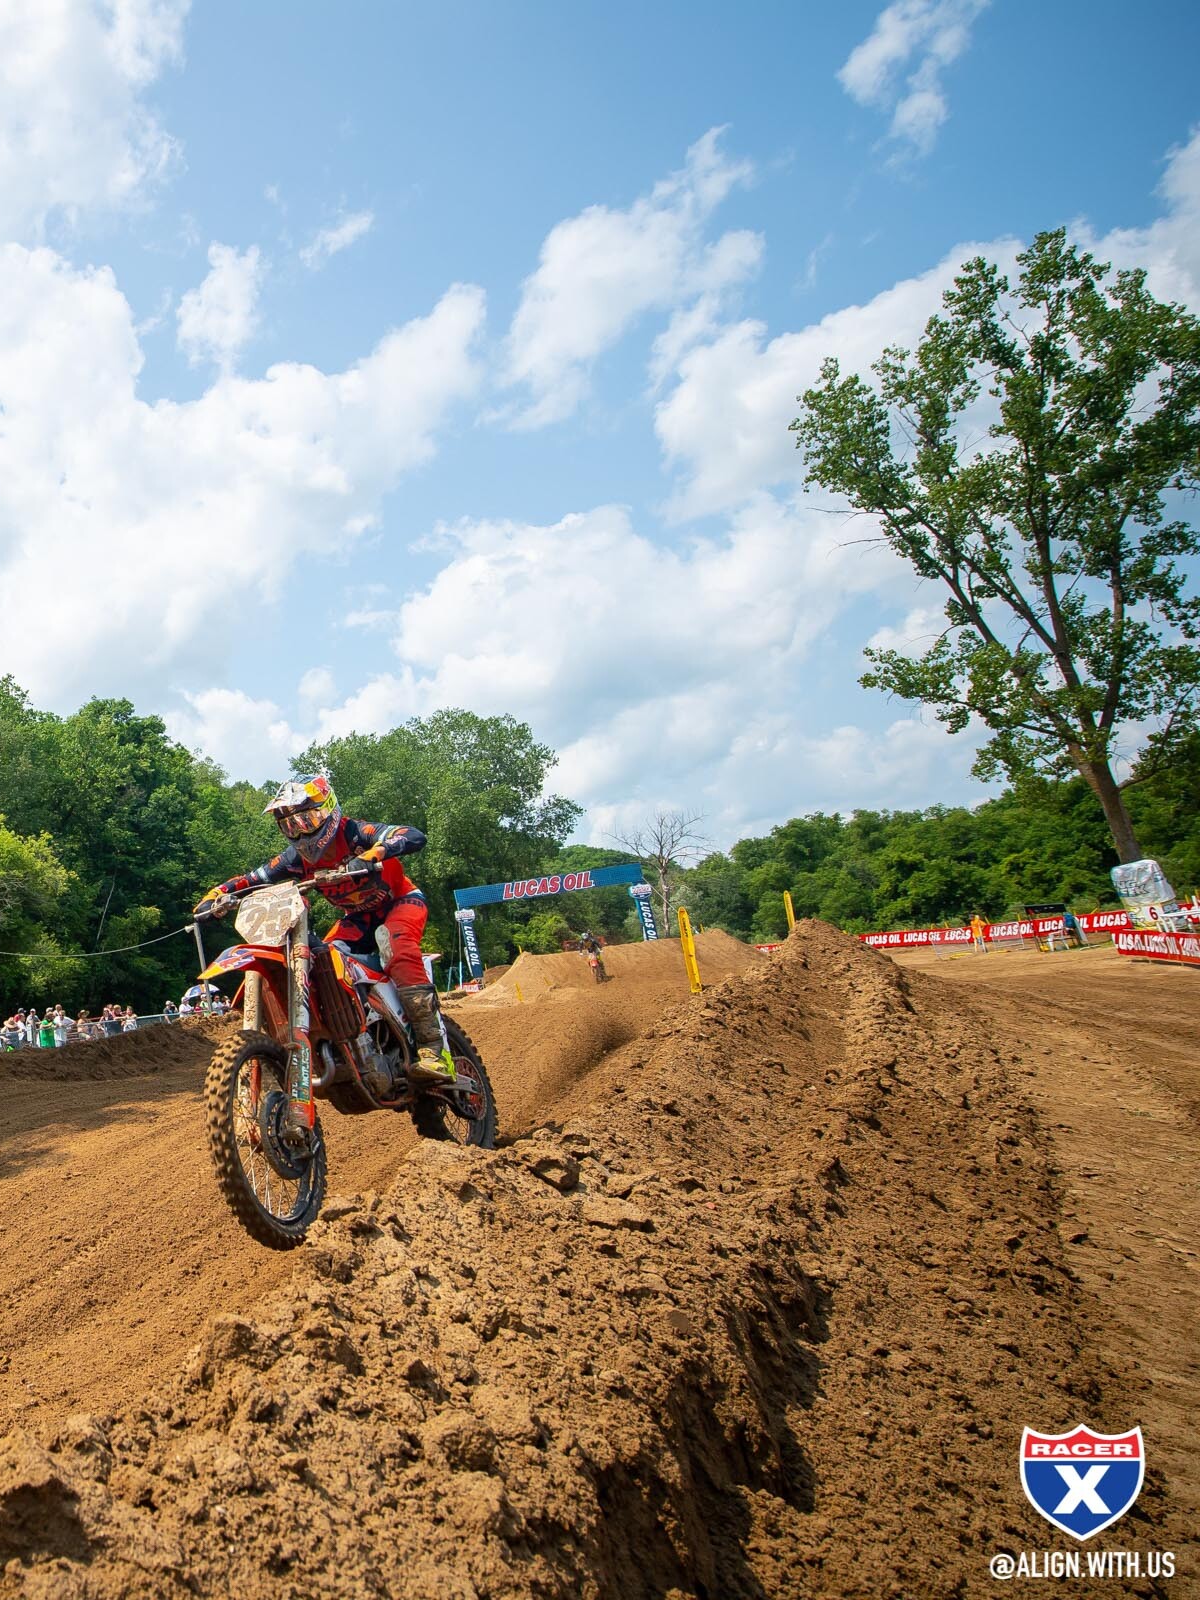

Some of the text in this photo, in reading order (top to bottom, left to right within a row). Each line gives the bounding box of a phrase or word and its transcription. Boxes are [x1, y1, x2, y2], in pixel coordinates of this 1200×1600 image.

[502, 870, 593, 900] LUCAS OIL
[245, 898, 293, 941] 25
[640, 901, 655, 929] LUCAS
[1149, 906, 1159, 920] 6
[463, 925, 477, 953] LUCAS
[865, 935, 888, 945] LUCAS
[889, 934, 901, 943] OIL
[904, 932, 928, 943] LUCAS
[944, 929, 971, 940] LUCAS
[989, 924, 1019, 937] LUCAS
[1038, 919, 1063, 932] LUCA
[1092, 911, 1128, 928] LUCAS
[469, 952, 481, 966] OIL
